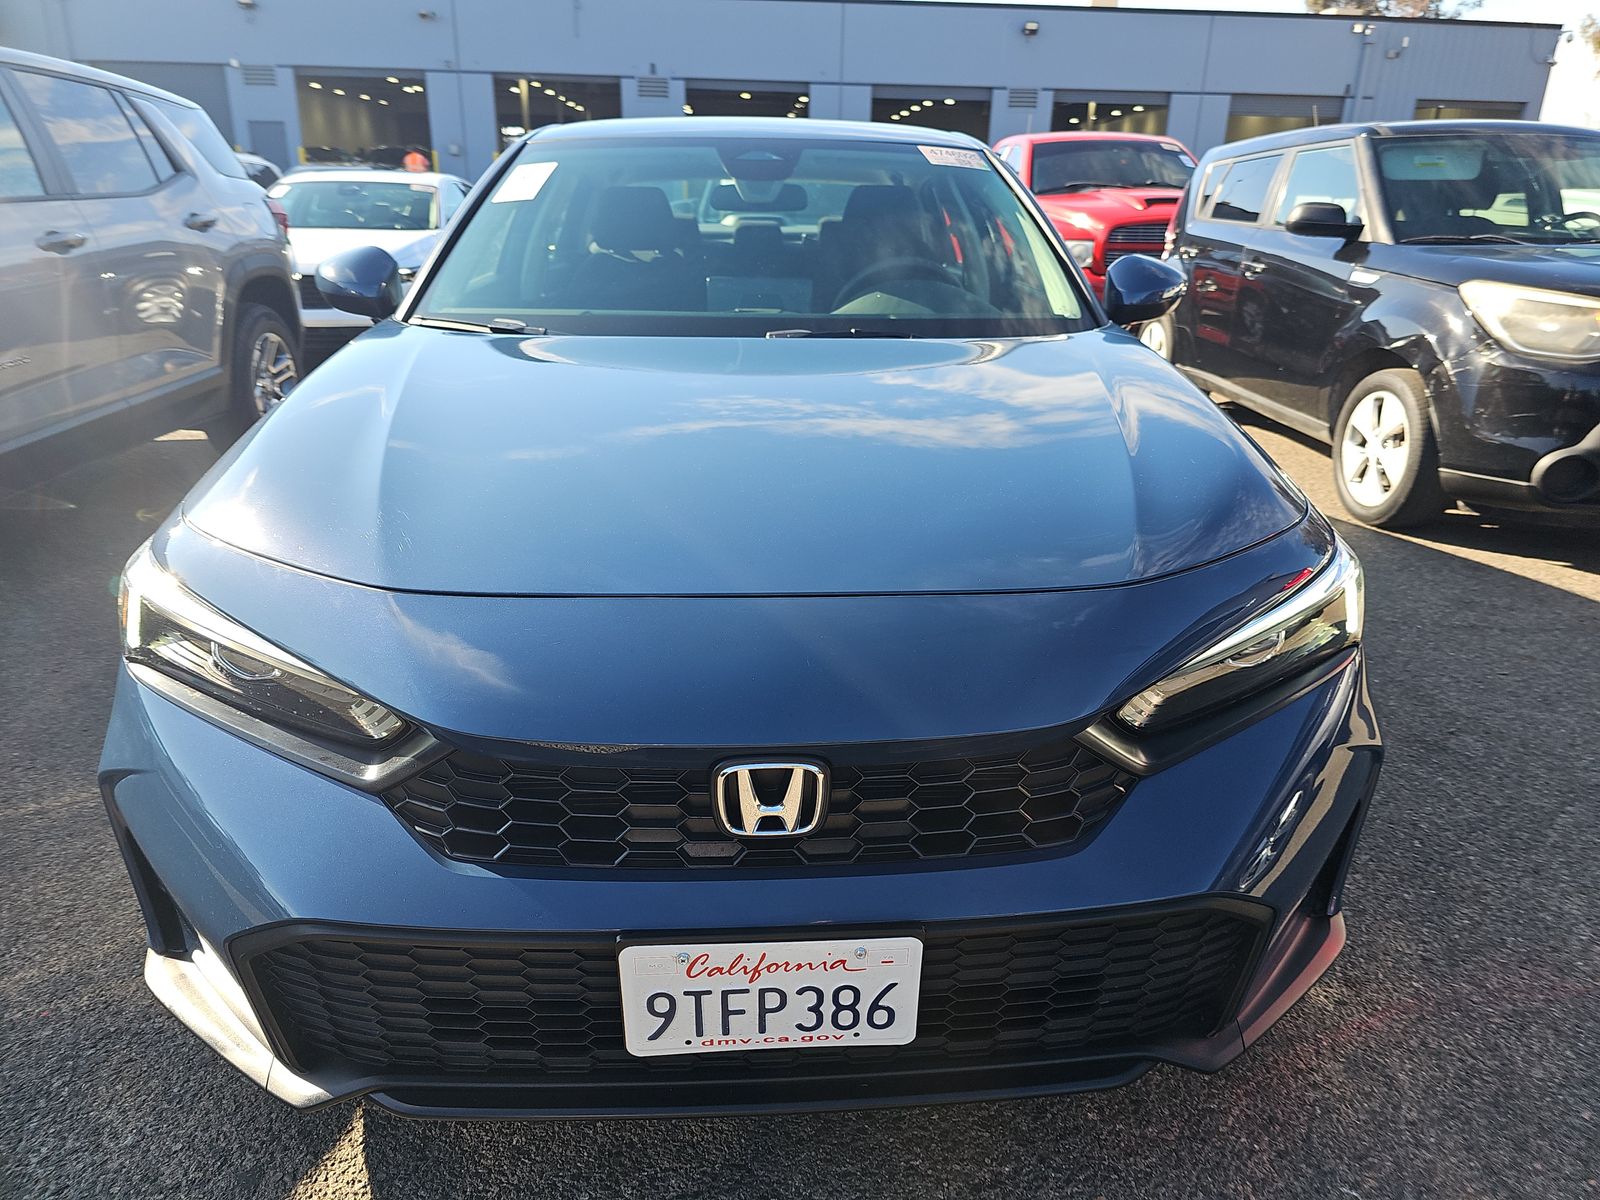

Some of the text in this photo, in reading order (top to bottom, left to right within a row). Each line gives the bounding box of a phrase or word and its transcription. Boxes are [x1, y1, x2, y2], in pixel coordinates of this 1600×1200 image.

[686, 952, 867, 984] California
[646, 982, 899, 1041] 9TFP386
[701, 1034, 845, 1047] dmv.ca.gov
